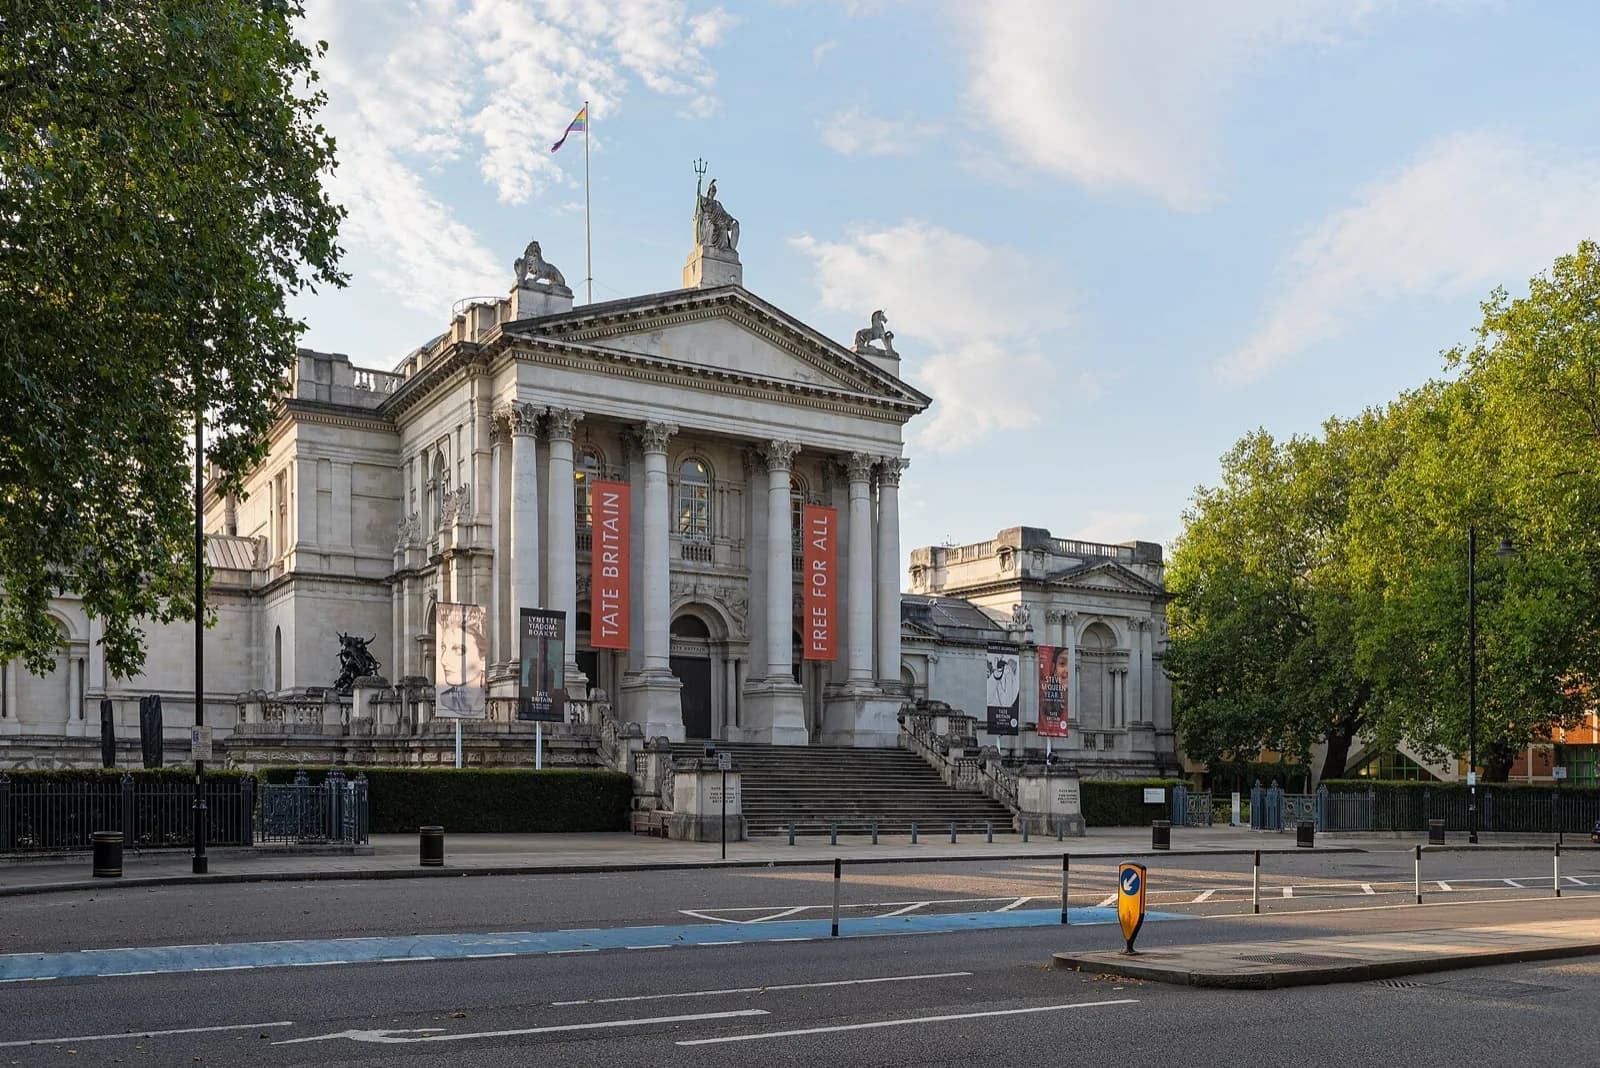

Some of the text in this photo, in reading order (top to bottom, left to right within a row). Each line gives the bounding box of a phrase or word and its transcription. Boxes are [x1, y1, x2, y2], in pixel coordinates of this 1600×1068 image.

[528, 616, 558, 625] LYNETTE
[602, 492, 620, 638] TATE BRITAIN
[812, 516, 828, 651] FREE FOR ALL
